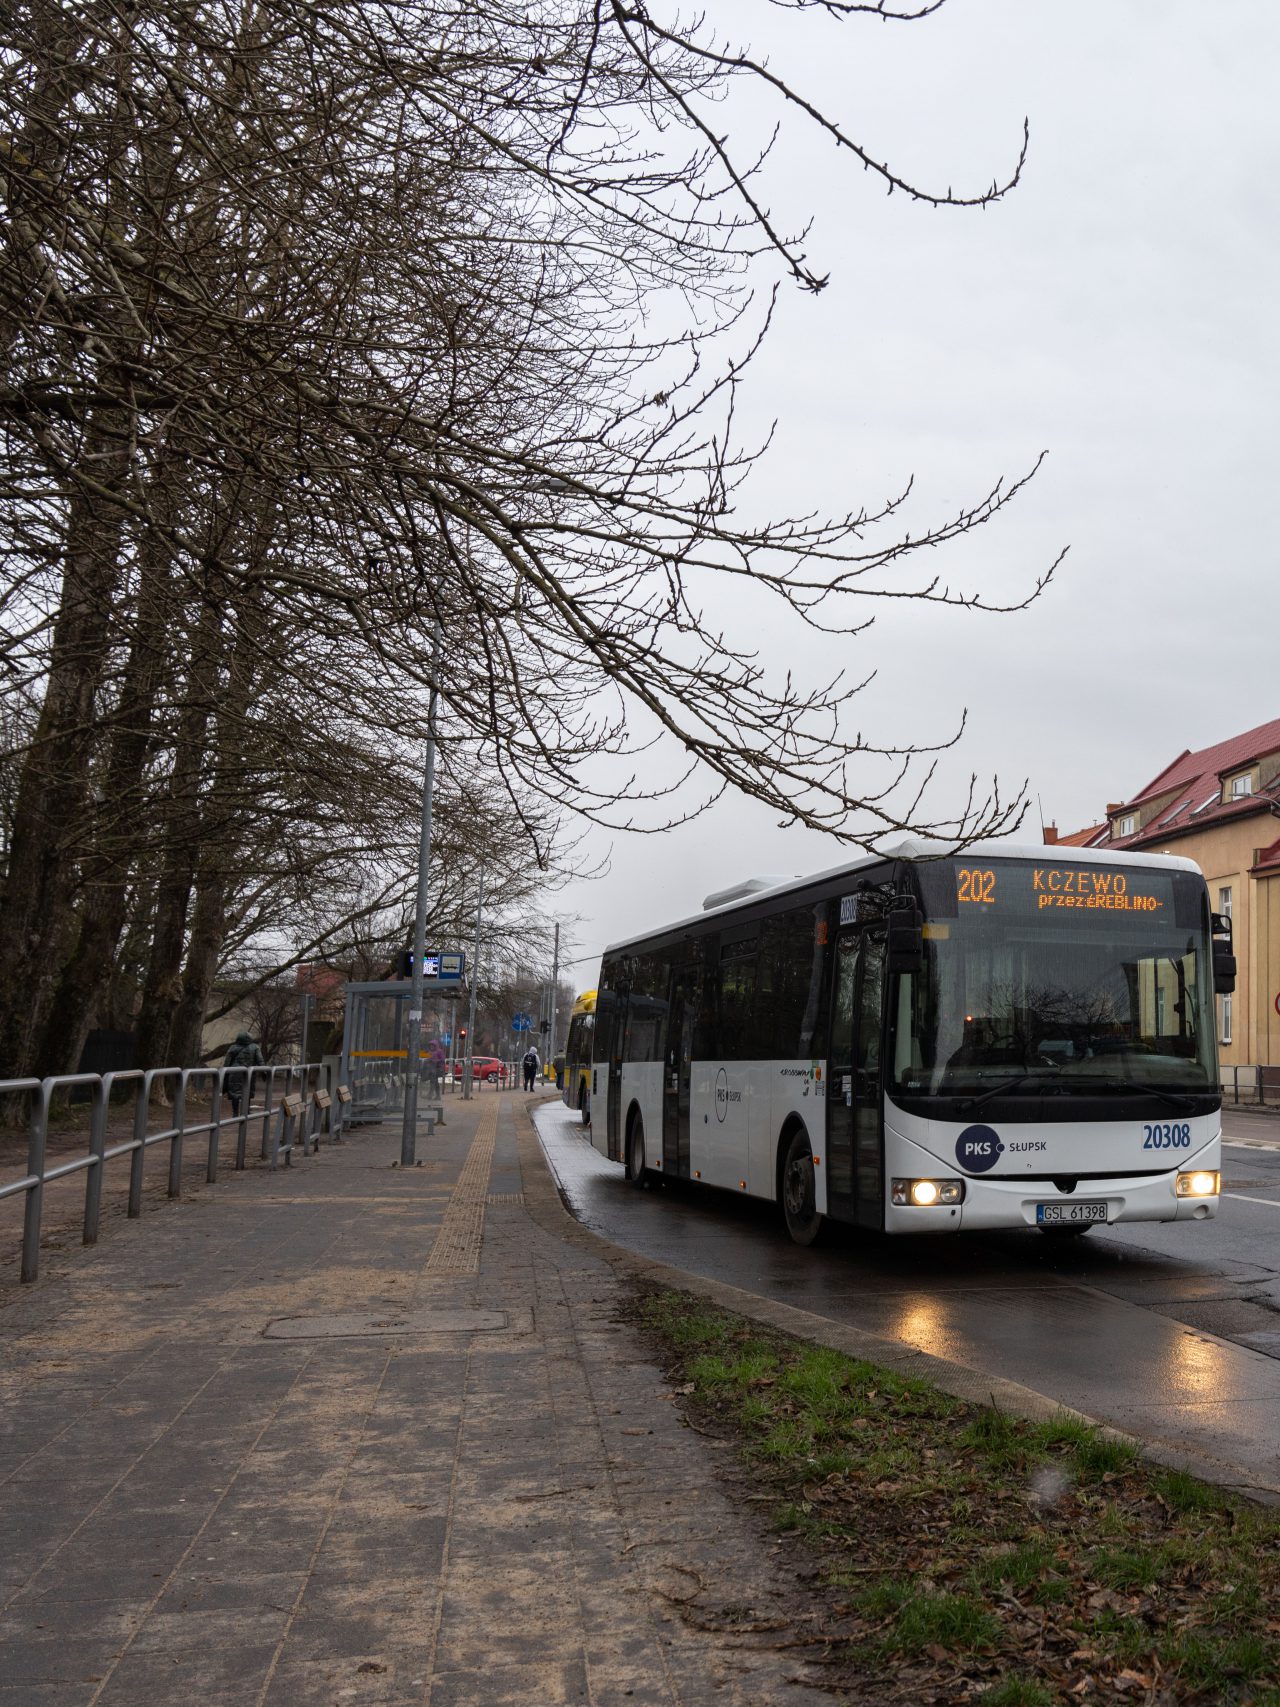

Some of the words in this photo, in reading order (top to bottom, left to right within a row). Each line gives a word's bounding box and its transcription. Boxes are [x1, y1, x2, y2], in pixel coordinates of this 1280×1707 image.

[958, 869, 996, 903] 202
[1033, 869, 1127, 895] KCZEWO
[965, 1142, 992, 1156] PKS
[1009, 1141, 1047, 1152] SŁUPSK
[1143, 1123, 1191, 1149] 20308
[1044, 1206, 1067, 1220] GSL
[1070, 1205, 1106, 1219] 61398
